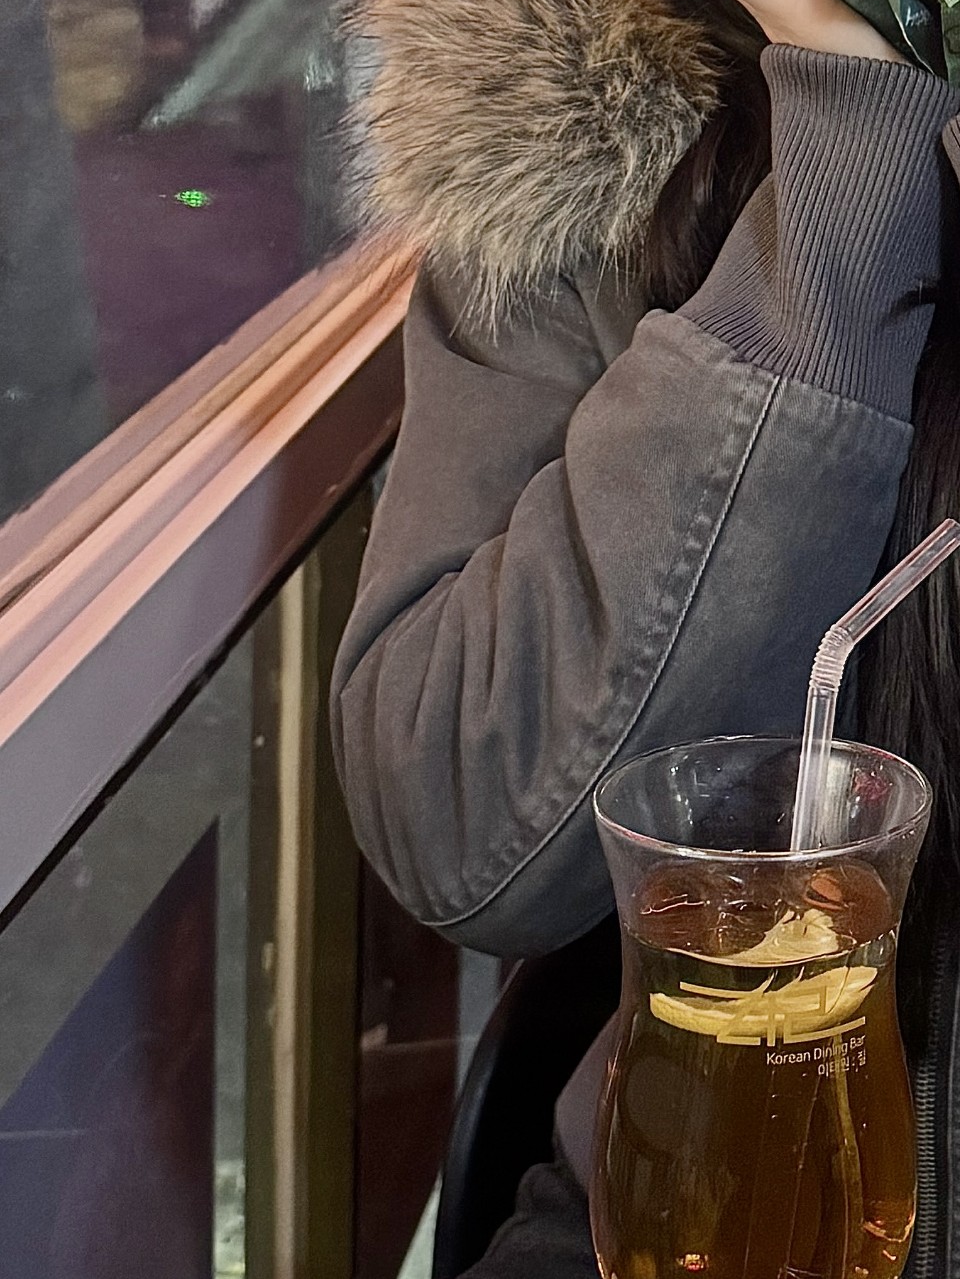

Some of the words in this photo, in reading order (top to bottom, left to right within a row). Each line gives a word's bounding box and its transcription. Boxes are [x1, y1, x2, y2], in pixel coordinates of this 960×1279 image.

[766, 1051, 811, 1065] Korean
[813, 1042, 848, 1061] Dining
[849, 1034, 866, 1050] Bar
